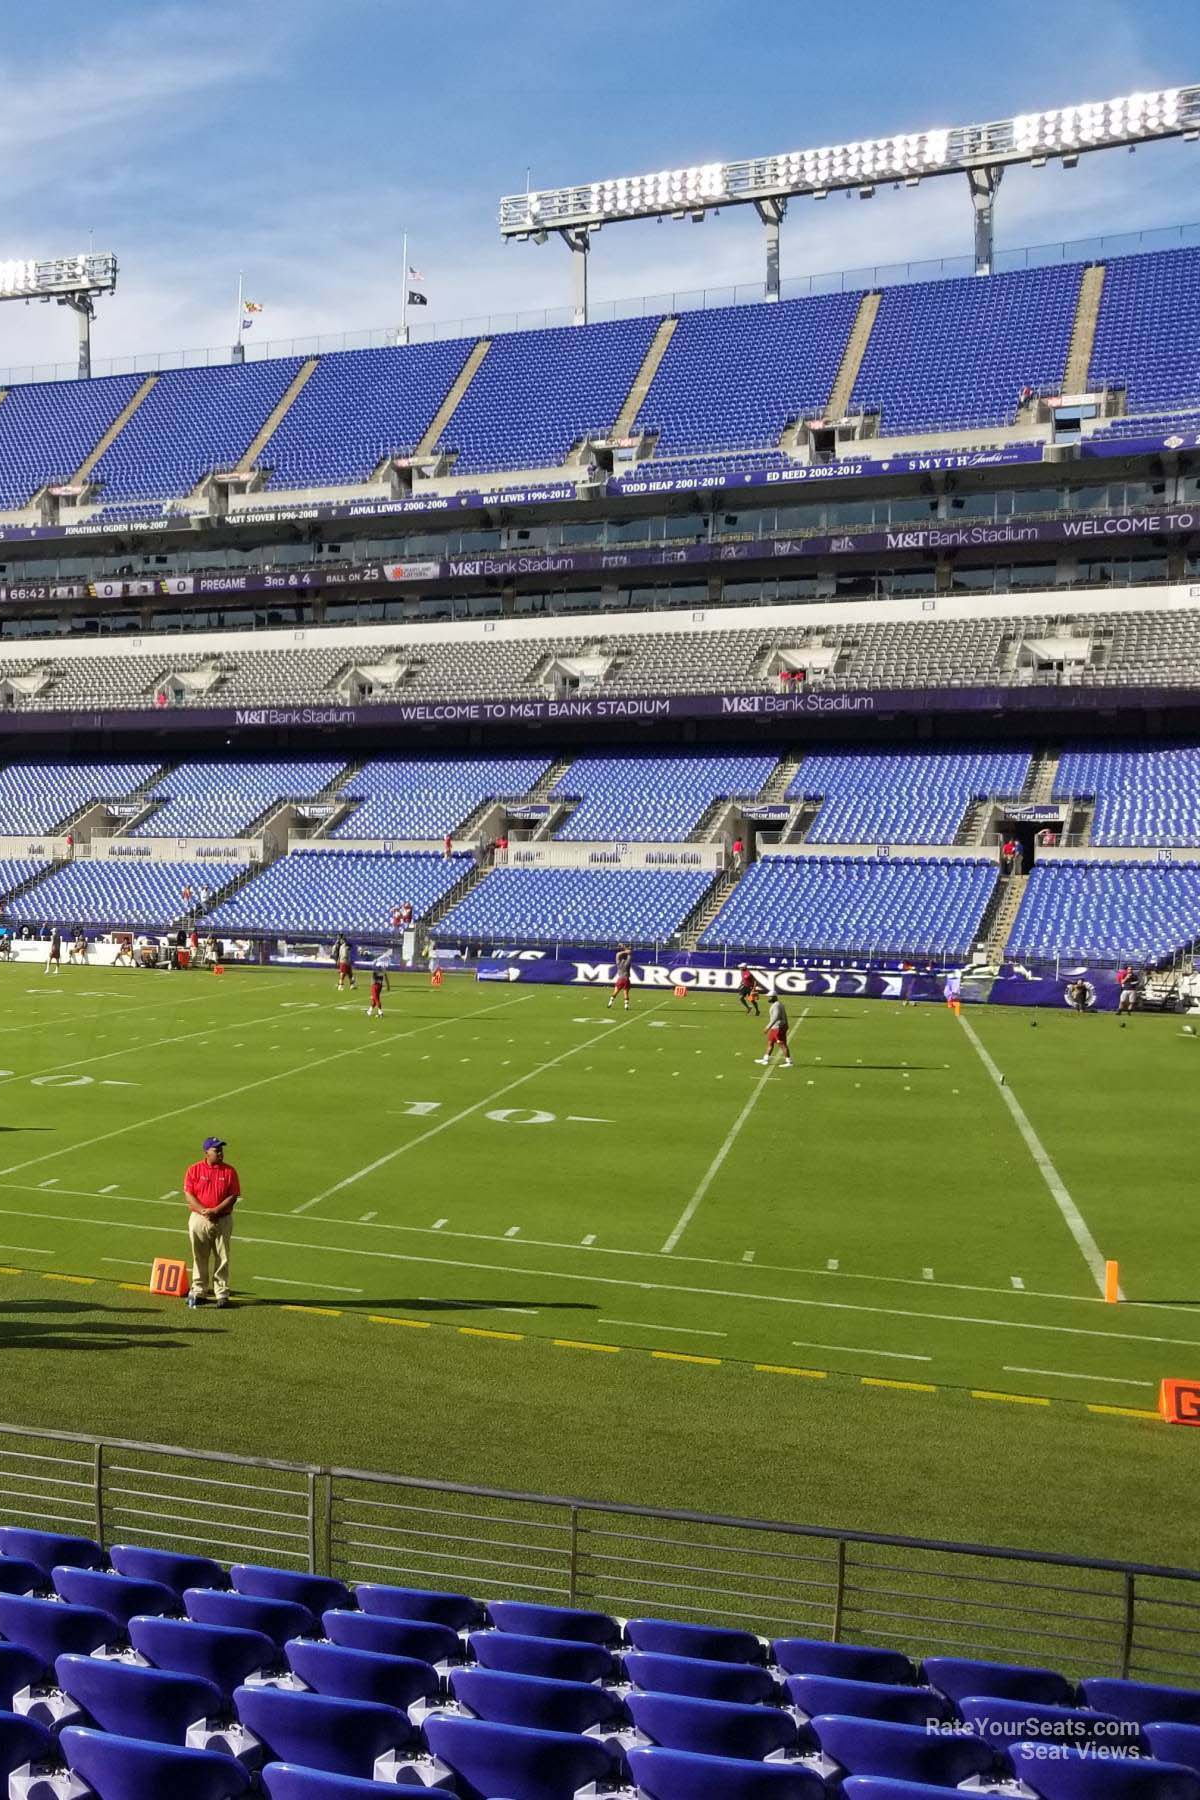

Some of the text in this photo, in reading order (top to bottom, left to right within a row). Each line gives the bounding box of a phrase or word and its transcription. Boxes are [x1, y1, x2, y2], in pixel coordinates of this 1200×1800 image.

[767, 465, 862, 482] ED REED 2002-2012
[621, 477, 726, 493] TODD HEAP 2001-2010
[483, 490, 571, 505] RAY LEWIS 1996-2012
[349, 500, 448, 515] JAMAL LEWIS 2000-2006
[225, 510, 319, 524] MATT STOVER 1996-2008
[1063, 514, 1193, 536] WELCOME TO
[64, 521, 168, 536] JONATHAN OGDEN 1996-2007
[886, 526, 1038, 549] M&T Bank Stadium
[449, 557, 574, 577] M&T Bank Stadium
[200, 577, 246, 591] PREGAME
[264, 573, 311, 587] 3RD & 4
[326, 569, 379, 583] BALL ON 25
[10, 588, 45, 600] 66:42
[104, 585, 113, 595] 0
[177, 581, 186, 592] 0
[401, 699, 670, 720] WELCOME TO M&T BANK STADIUM
[721, 694, 874, 713] M&T Bank Stadium
[235, 709, 355, 725] M&T Bank Stadium
[387, 1101, 557, 1124] 10
[157, 1263, 181, 1292] 10
[1175, 1385, 1200, 1420] G
